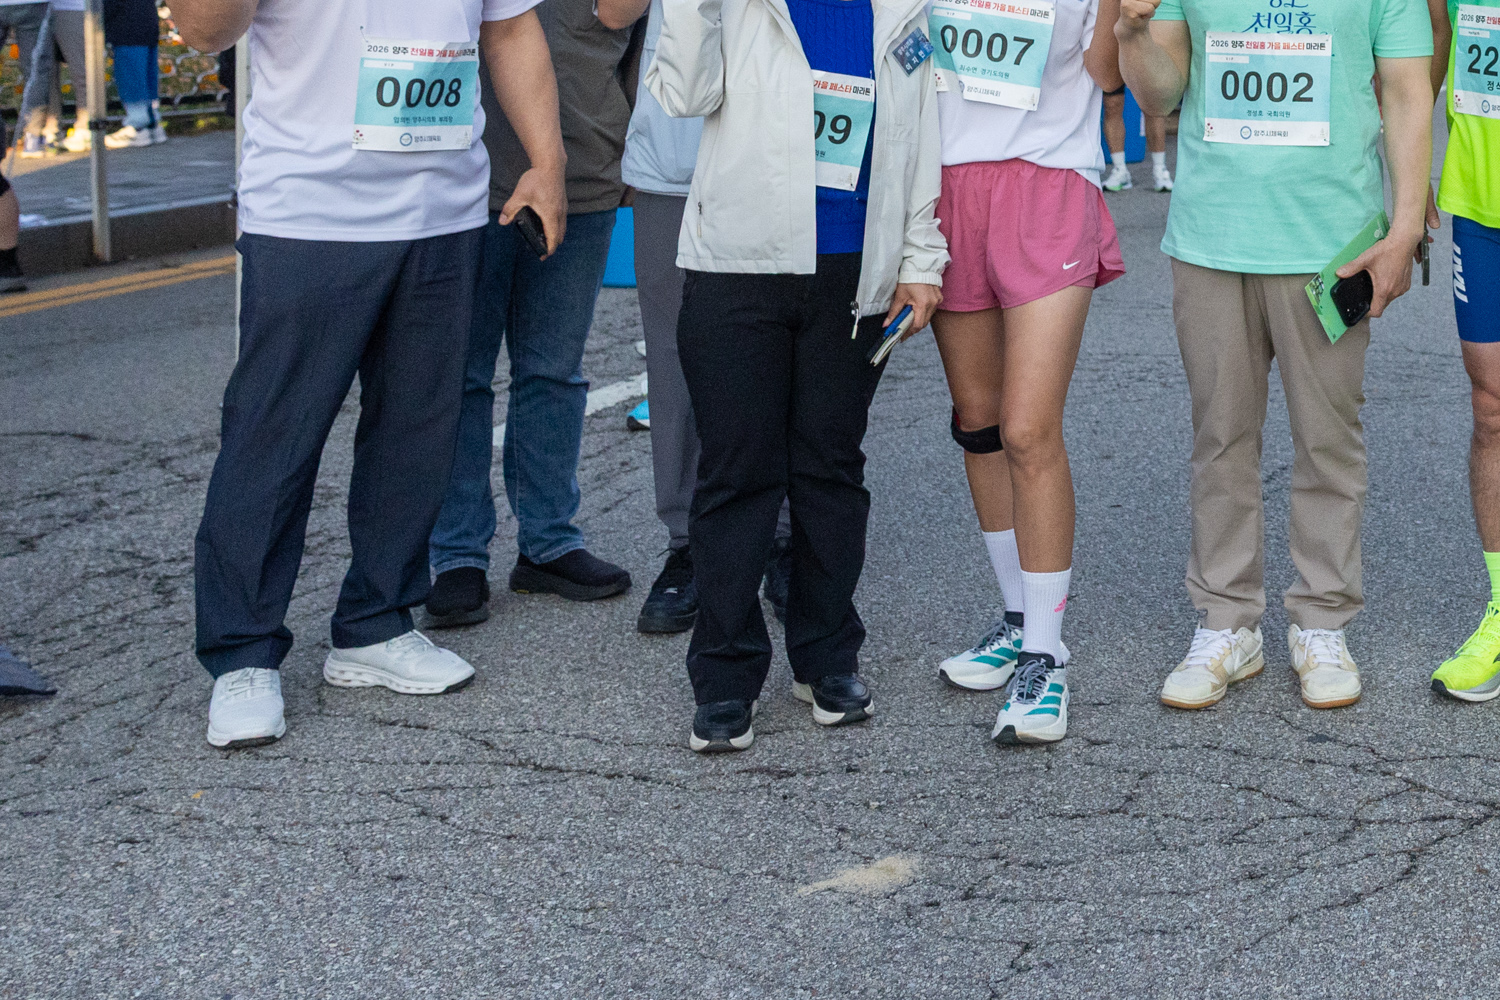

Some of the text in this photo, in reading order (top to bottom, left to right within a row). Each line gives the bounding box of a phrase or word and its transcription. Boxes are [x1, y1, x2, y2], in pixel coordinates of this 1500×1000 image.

[970, 0, 991, 9] 천일홍
[992, 2, 1006, 12] 가을
[1007, 5, 1029, 15] 페스타
[367, 45, 389, 53] 2026
[392, 46, 409, 55] 양주
[410, 47, 434, 57] 천일홍
[941, 24, 1035, 65] 0007
[1231, 40, 1244, 49] 양주
[1245, 41, 1266, 50] 천일홍
[1267, 41, 1281, 50] 가을
[1282, 42, 1305, 50] 페스타
[376, 76, 462, 108] 0008
[829, 82, 852, 94] 페스타
[1221, 69, 1314, 103] 0002
